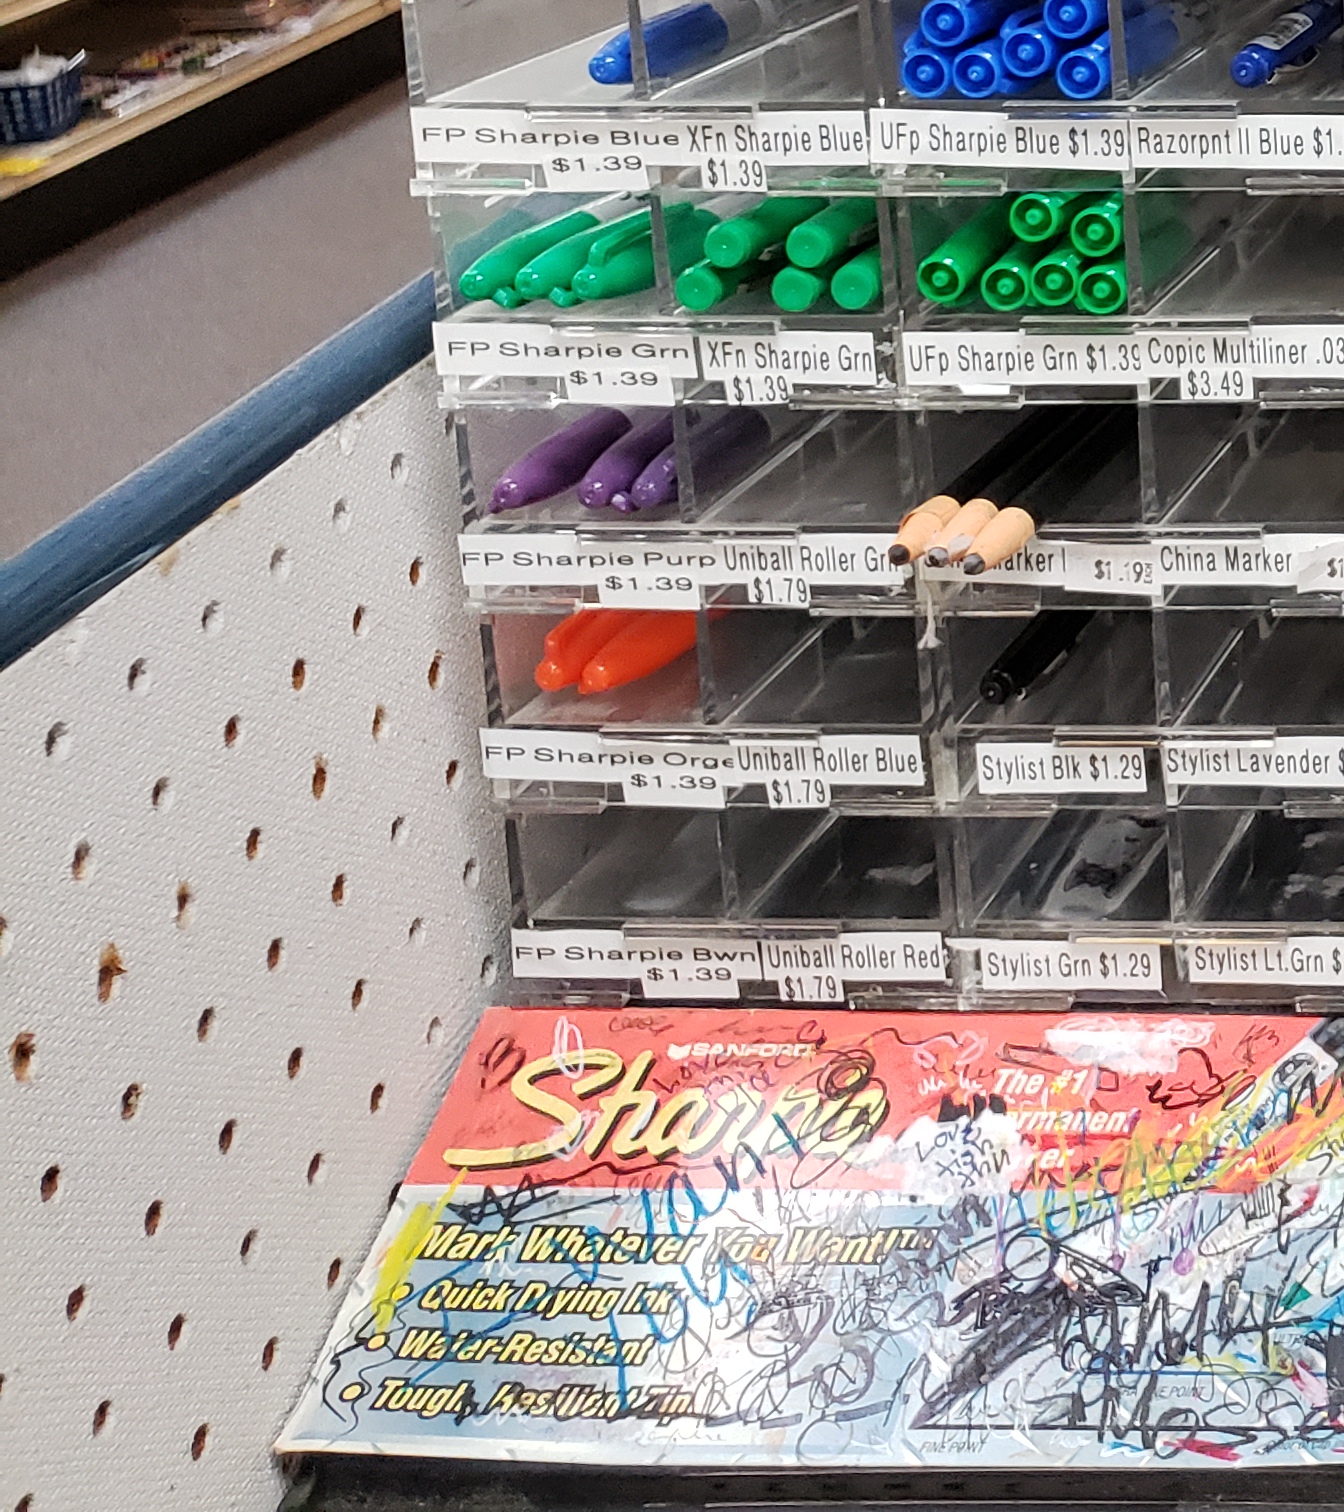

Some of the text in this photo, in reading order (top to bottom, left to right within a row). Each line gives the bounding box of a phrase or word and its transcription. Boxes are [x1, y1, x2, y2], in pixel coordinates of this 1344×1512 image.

[1148, 338, 1206, 367] Copic
[1213, 338, 1308, 367] Multiliner
[1187, 370, 1244, 397] $3.49
[1160, 544, 1291, 572] China Marker
[982, 753, 1142, 784] Stylist Blk $1.29
[421, 1225, 703, 1263] Mark Whatever
[422, 1280, 517, 1310] Quick
